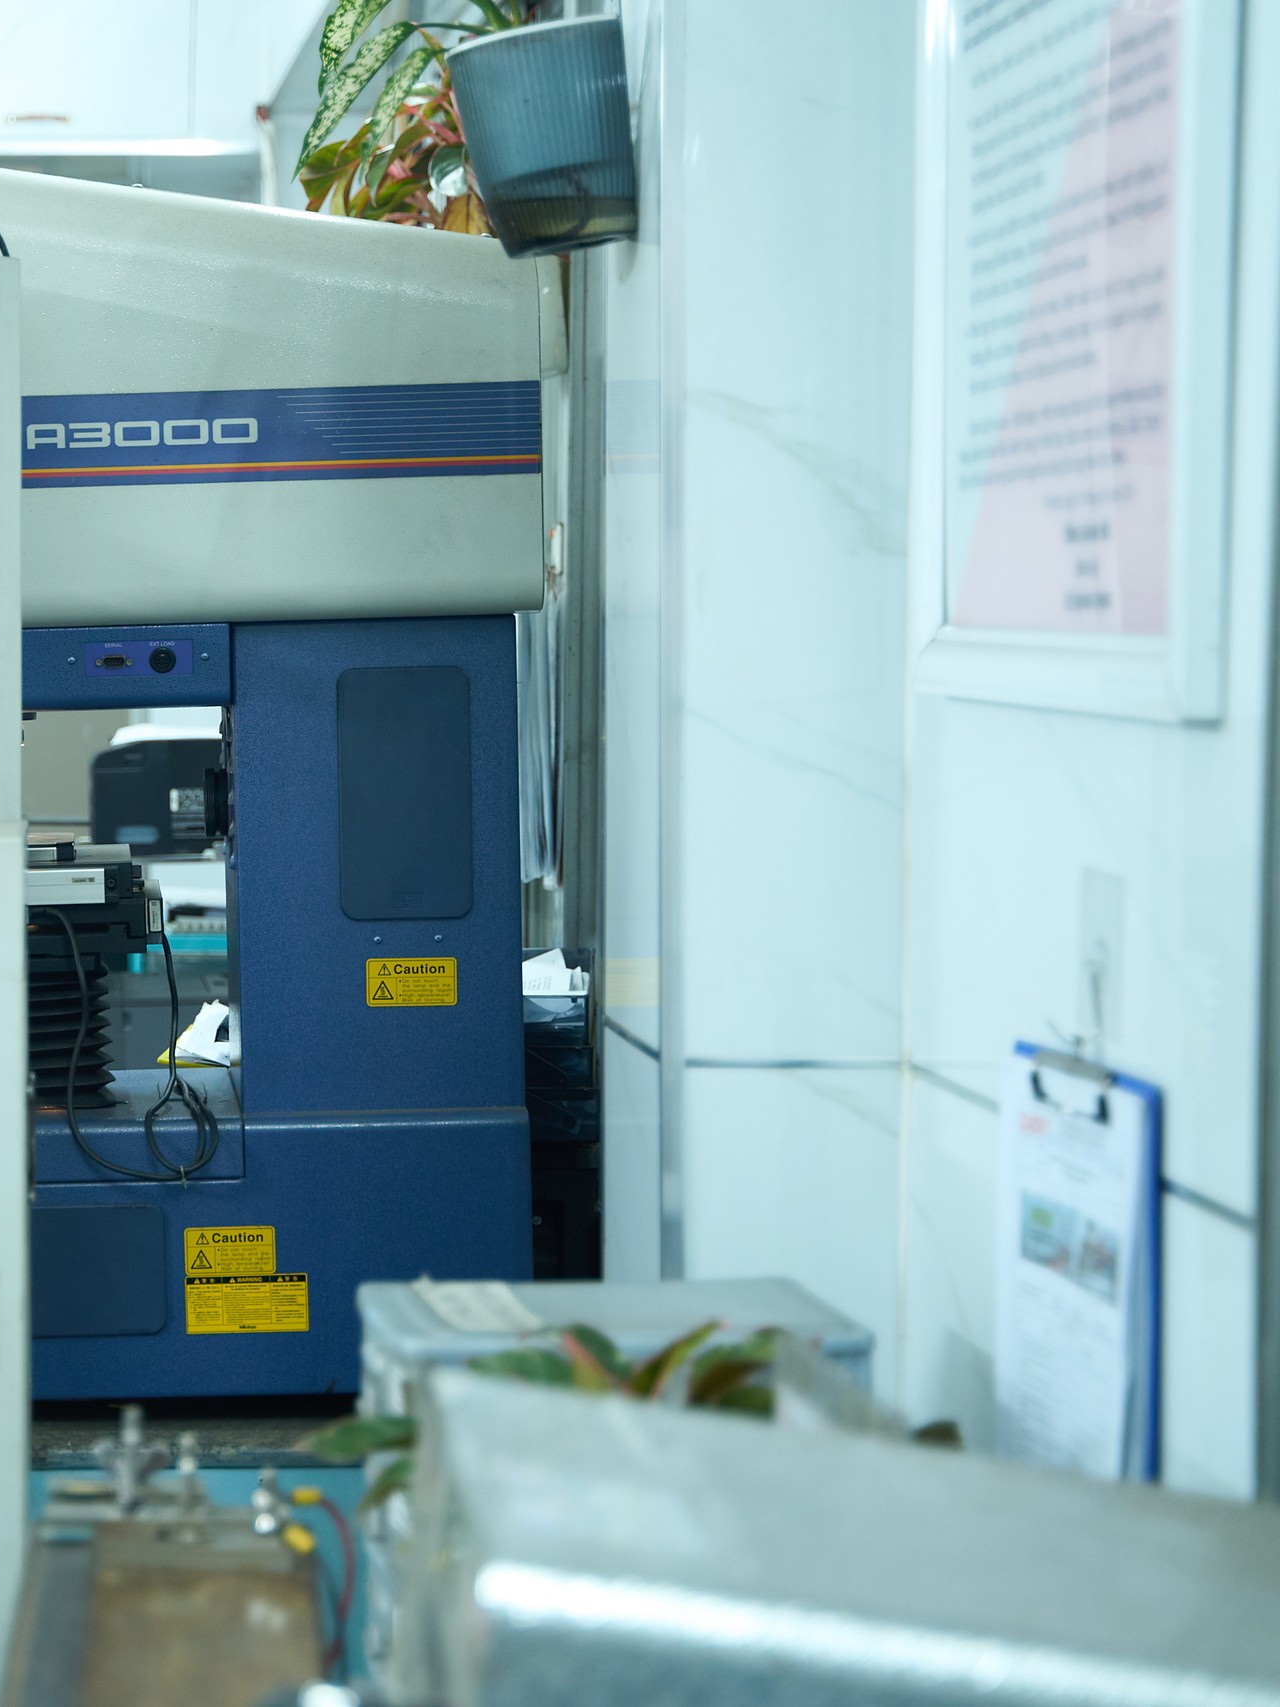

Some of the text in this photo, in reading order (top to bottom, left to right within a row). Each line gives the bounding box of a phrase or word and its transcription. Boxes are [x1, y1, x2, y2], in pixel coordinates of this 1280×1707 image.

[26, 417, 258, 450] A3000
[393, 963, 445, 975] Caution
[211, 1232, 264, 1243] Caution
